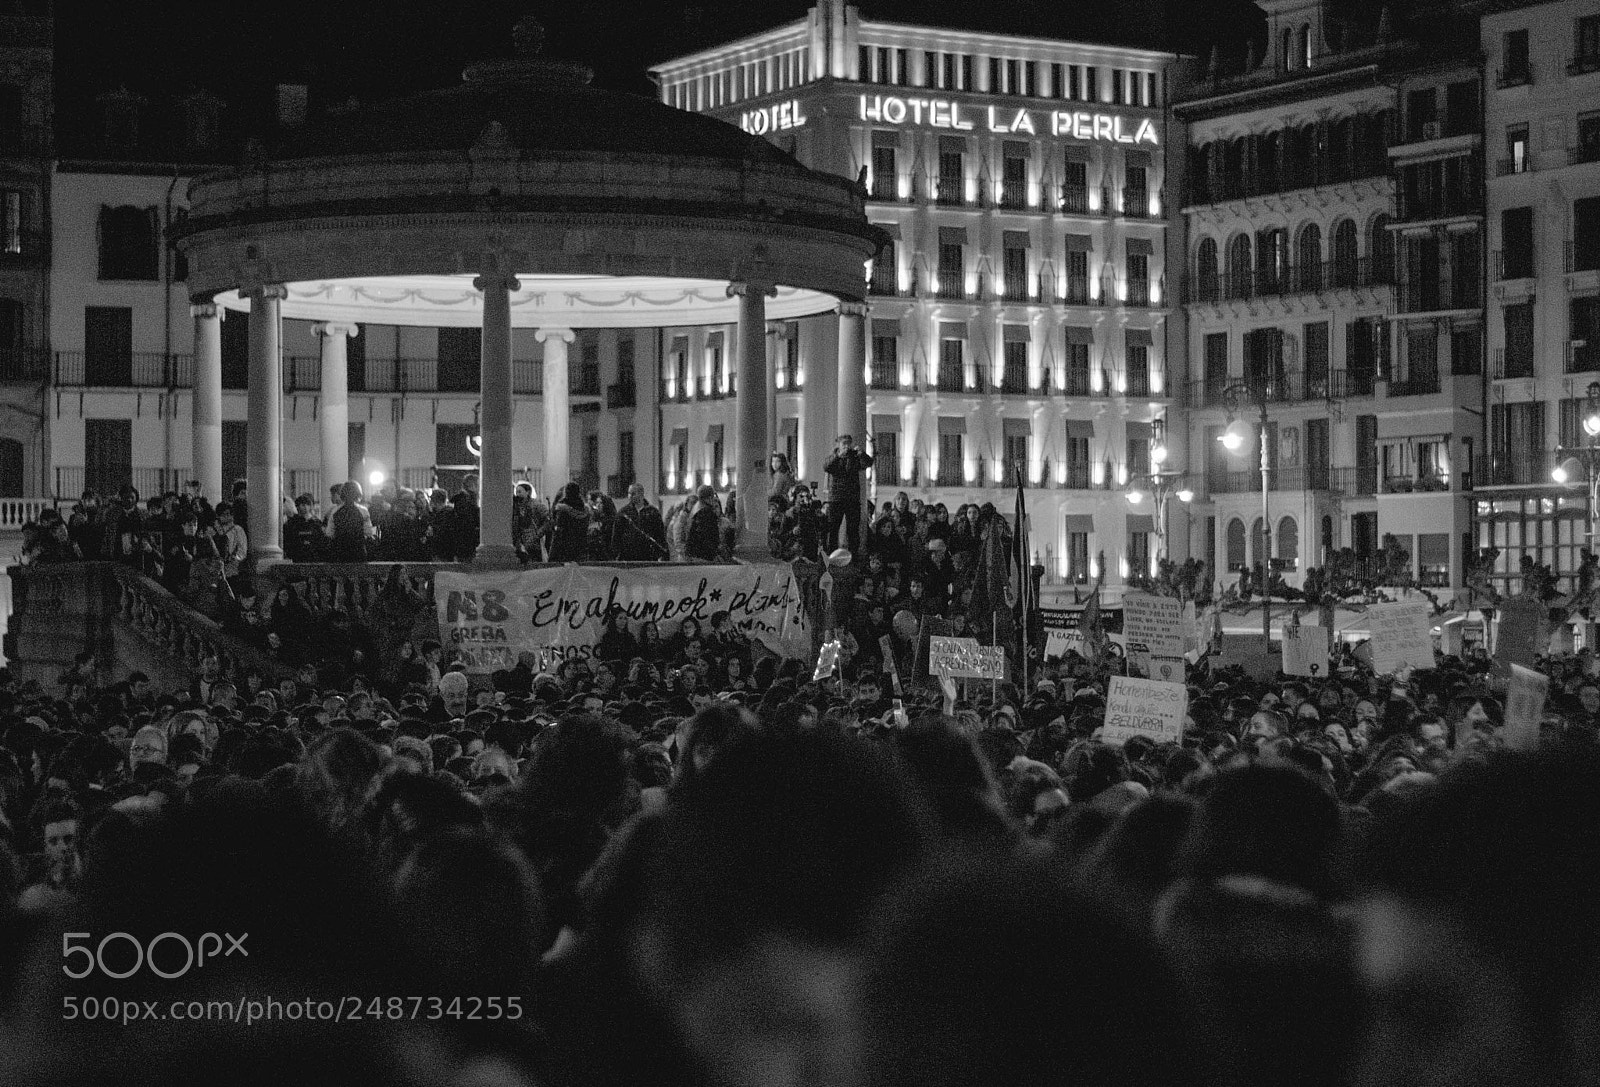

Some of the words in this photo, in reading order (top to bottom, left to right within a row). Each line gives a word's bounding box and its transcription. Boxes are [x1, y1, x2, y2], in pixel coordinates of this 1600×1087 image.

[741, 98, 806, 136] HOTEL
[857, 94, 974, 131] HOTEL
[986, 104, 1035, 136] LA
[1050, 110, 1159, 145] PERLA
